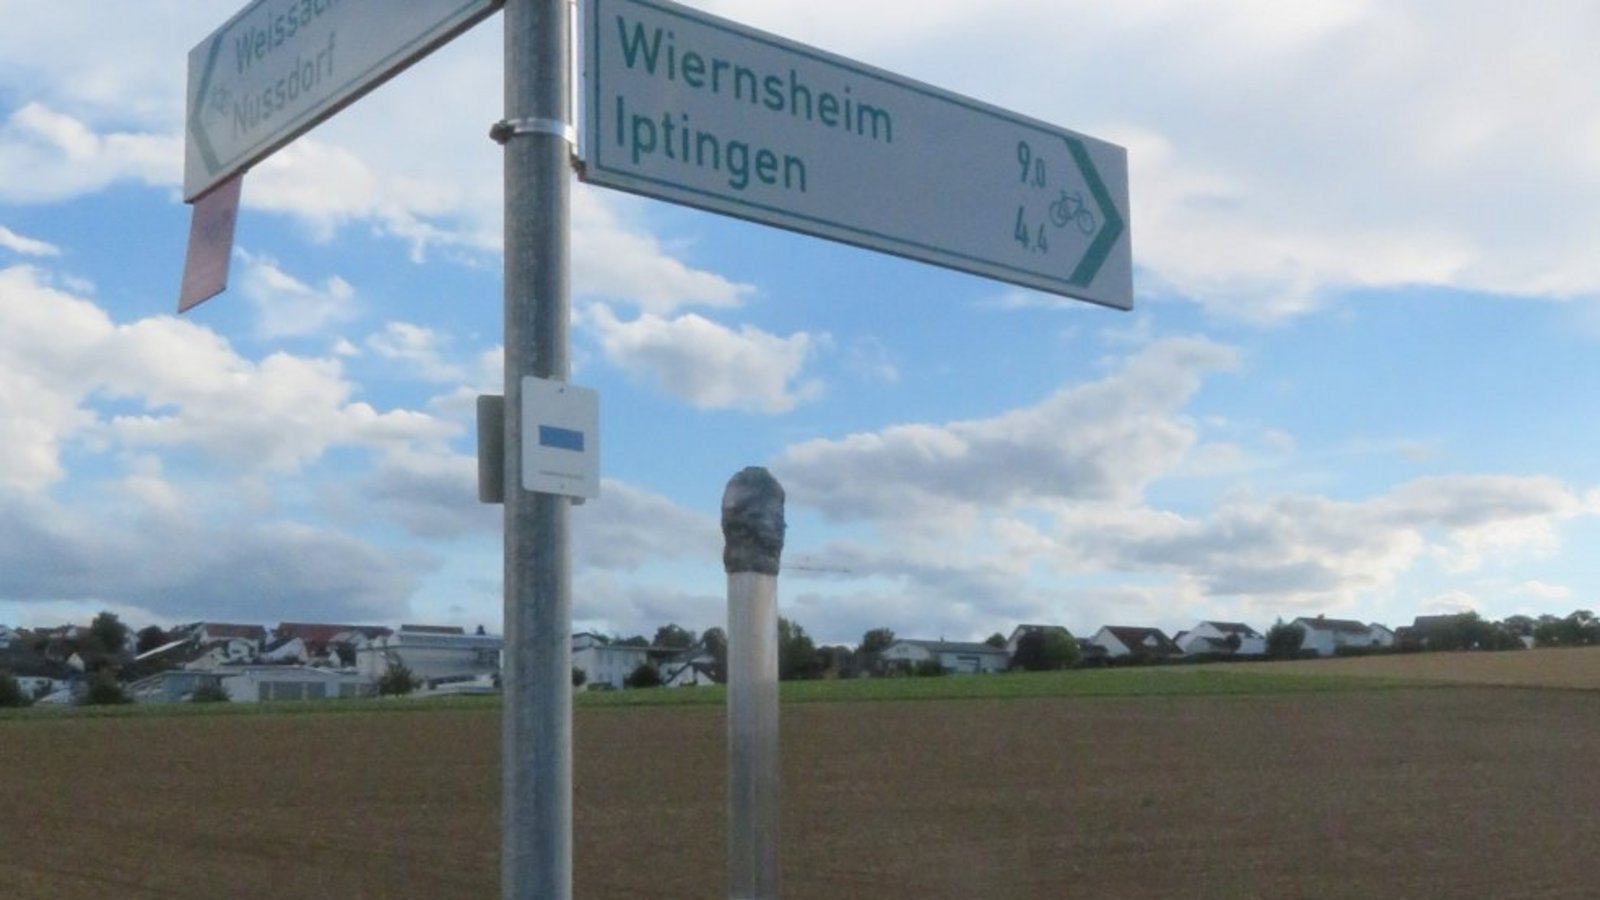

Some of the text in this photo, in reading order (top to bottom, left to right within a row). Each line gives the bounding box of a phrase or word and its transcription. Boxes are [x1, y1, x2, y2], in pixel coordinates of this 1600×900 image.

[231, 32, 336, 140] Nussdorf
[235, 0, 338, 74] Weissac
[615, 15, 893, 143] Wiernsheim
[615, 95, 807, 192] Iptingen
